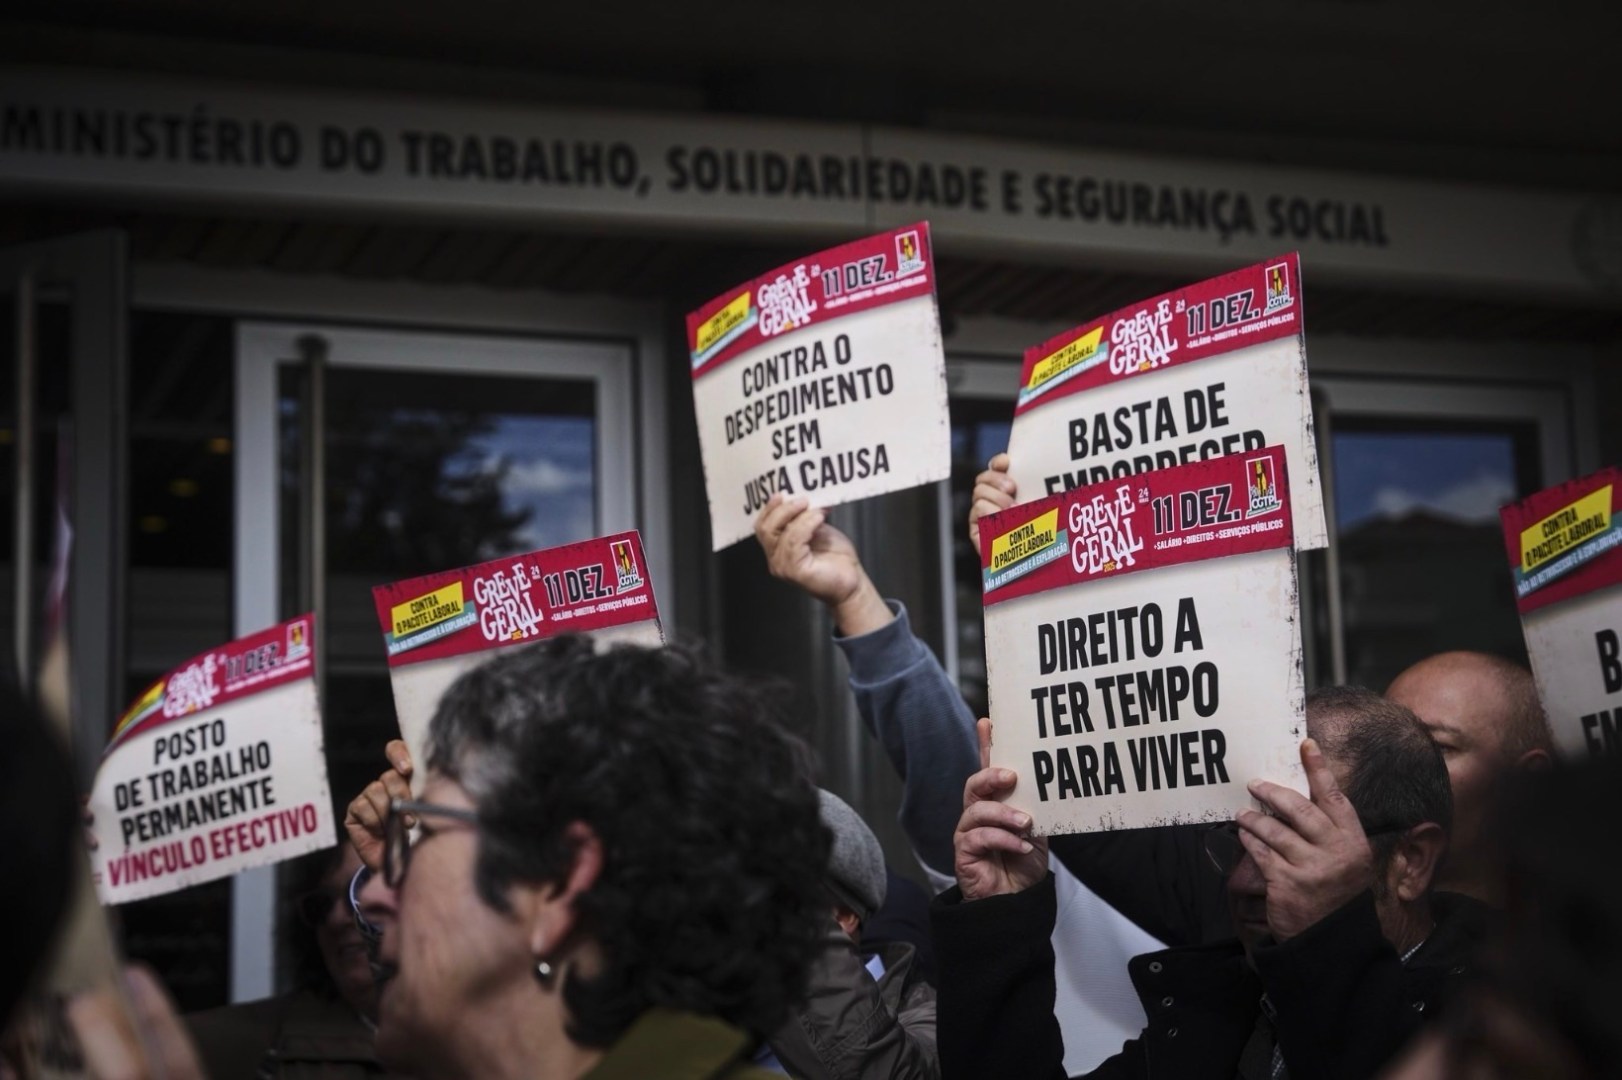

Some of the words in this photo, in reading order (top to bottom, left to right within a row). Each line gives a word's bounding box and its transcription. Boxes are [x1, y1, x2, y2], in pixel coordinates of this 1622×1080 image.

[2, 104, 301, 169] MINISTÉRIO
[320, 126, 384, 174] DO
[401, 130, 651, 197] TRABALHO,
[667, 146, 988, 213] SOLIDARIEDADE
[1004, 171, 1021, 214] E
[1033, 174, 1257, 243] SEGURANÇA
[1266, 198, 1389, 248] SOCIAL
[844, 253, 894, 292] DEZ.
[1111, 299, 1173, 344] GREVE
[1186, 302, 1207, 337] 11
[1209, 290, 1261, 332] DEZ.
[742, 340, 828, 398] CONTRA
[834, 334, 852, 366] O
[1109, 325, 1179, 375] GERAL
[724, 363, 895, 446] DESPEDIMENTO
[1069, 396, 1178, 461] BASTA
[1184, 382, 1230, 434] DE
[772, 419, 823, 460] SEM
[743, 466, 795, 515] JUSTA
[799, 444, 891, 492] CAUSA
[1069, 484, 1136, 537] GREVE
[1152, 494, 1175, 535] 11
[1180, 483, 1242, 531] DEZ.
[1251, 518, 1284, 534] PÚBLICOS
[1542, 506, 1579, 538] CONTRA
[1563, 512, 1607, 546] LABORAL
[999, 544, 1024, 566] PACOTE
[1023, 529, 1054, 554] LABORAL
[1009, 523, 1035, 546] CONTRA
[1071, 517, 1144, 575] GERAL
[410, 594, 439, 615] CONTRA
[473, 562, 532, 608] GREVE
[544, 573, 565, 608] 11
[565, 563, 614, 605] DEZ.
[428, 600, 462, 622] LABORAL
[480, 591, 545, 642] GERAL
[1037, 602, 1164, 676] DIREITO
[1174, 597, 1204, 653] A
[1031, 680, 1095, 739] TER
[1095, 661, 1219, 730] TEMPO
[153, 718, 227, 766] POSTO
[1032, 741, 1127, 801] PARA
[1127, 728, 1231, 792] VIVER
[114, 778, 143, 812] DE
[148, 740, 272, 802] TRABALHO
[120, 775, 276, 846] PERMANENTE
[107, 835, 206, 887] VÍNCULO
[208, 803, 319, 860] EFECTIVO
